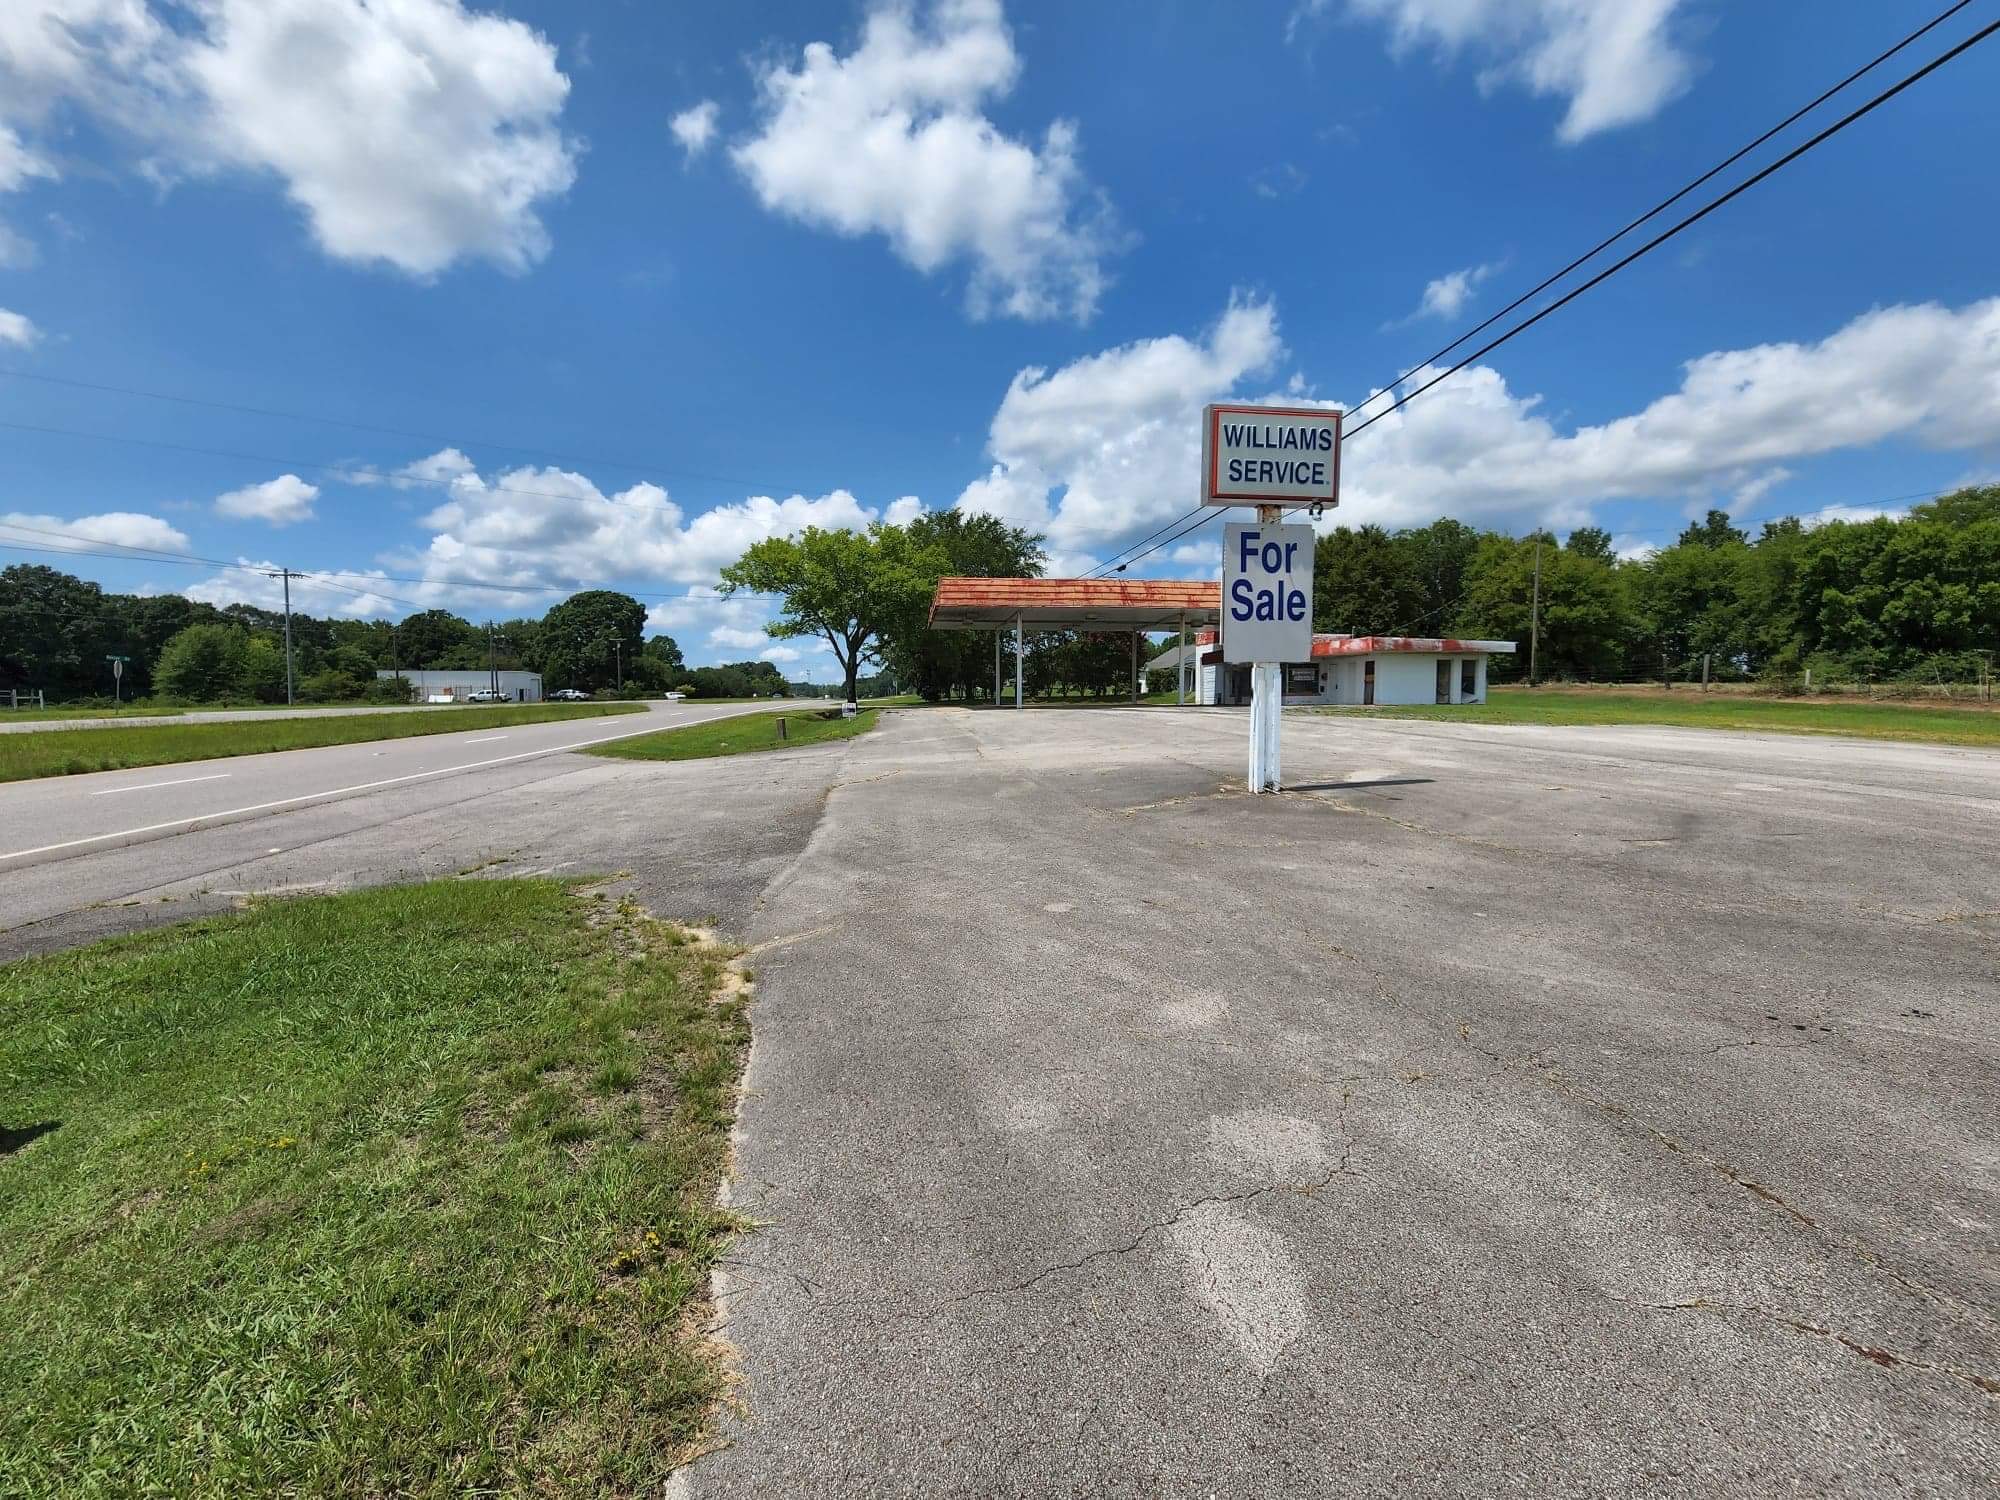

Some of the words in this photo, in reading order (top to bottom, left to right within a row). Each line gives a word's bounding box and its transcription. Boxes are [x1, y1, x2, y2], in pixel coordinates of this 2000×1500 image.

[1223, 424, 1332, 451] WILLIAMS
[1240, 531, 1298, 574] For
[1231, 578, 1306, 622] Sale
